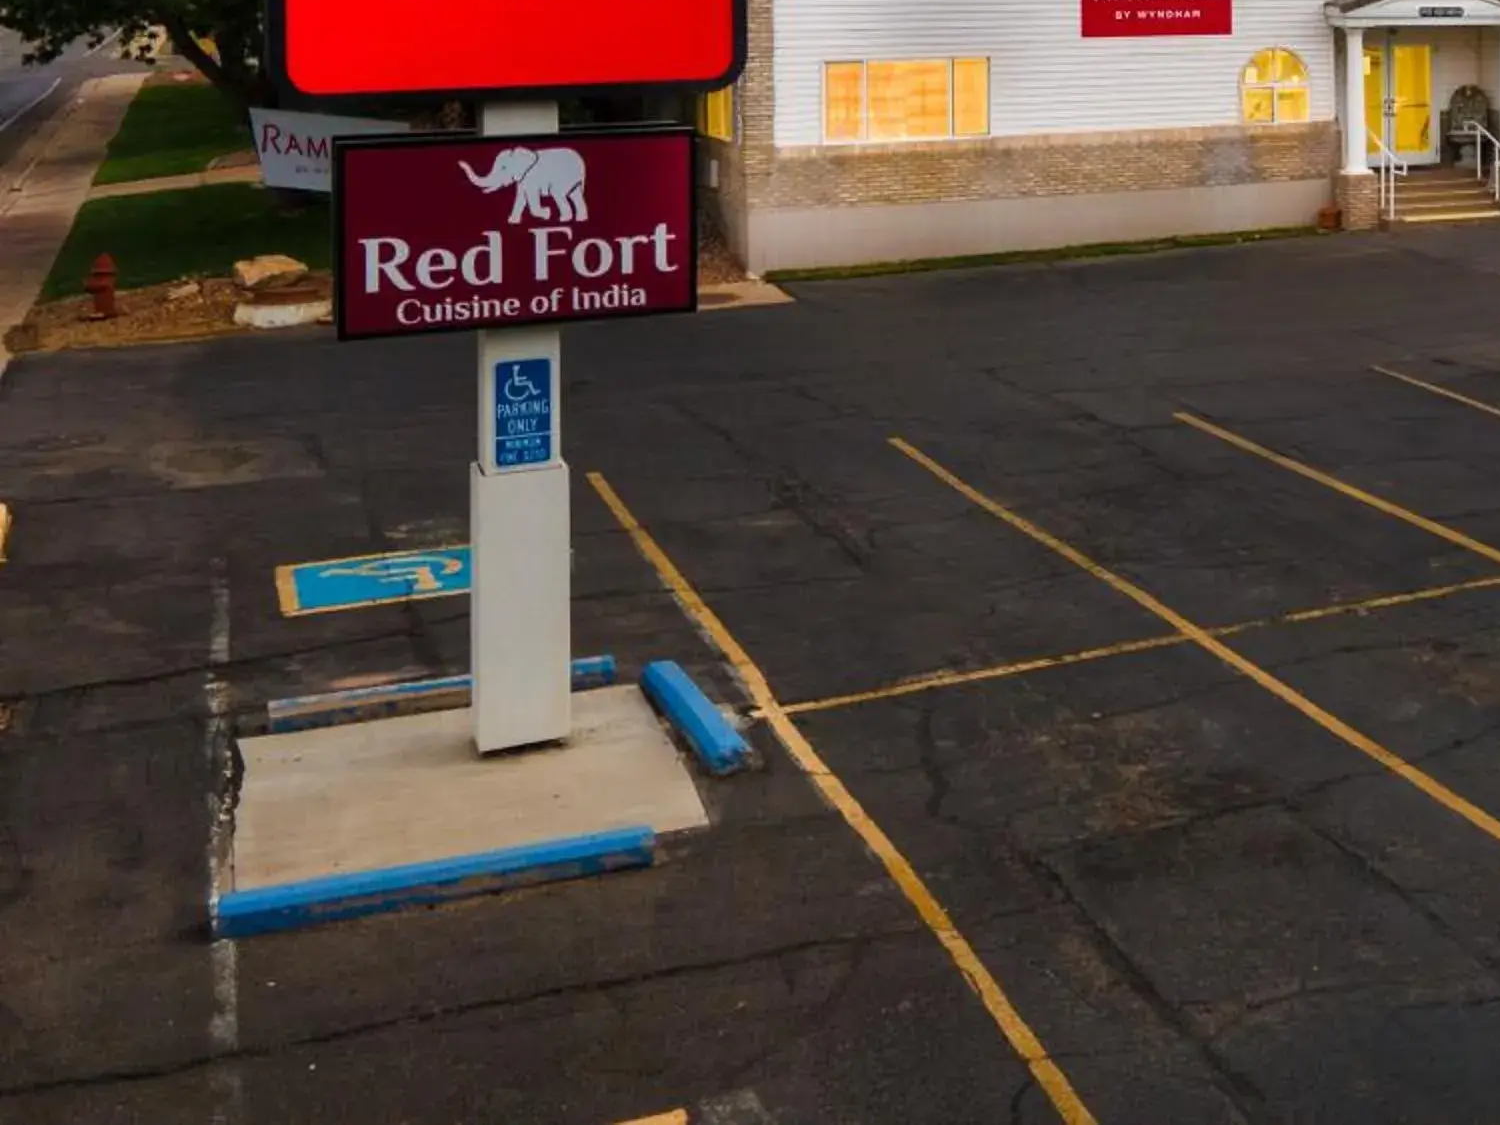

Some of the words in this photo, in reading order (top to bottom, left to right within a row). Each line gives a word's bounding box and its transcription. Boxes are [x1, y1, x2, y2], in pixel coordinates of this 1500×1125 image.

[1115, 10, 1131, 20] BY
[1137, 9, 1201, 19] WYNDHAM
[261, 123, 329, 159] RAM
[358, 231, 503, 294] Red
[528, 223, 679, 281] Fort
[396, 296, 521, 325] Cuisine
[530, 288, 564, 313] of
[571, 285, 647, 310] India
[497, 398, 549, 419] PARKING
[507, 417, 538, 434] ONLY
